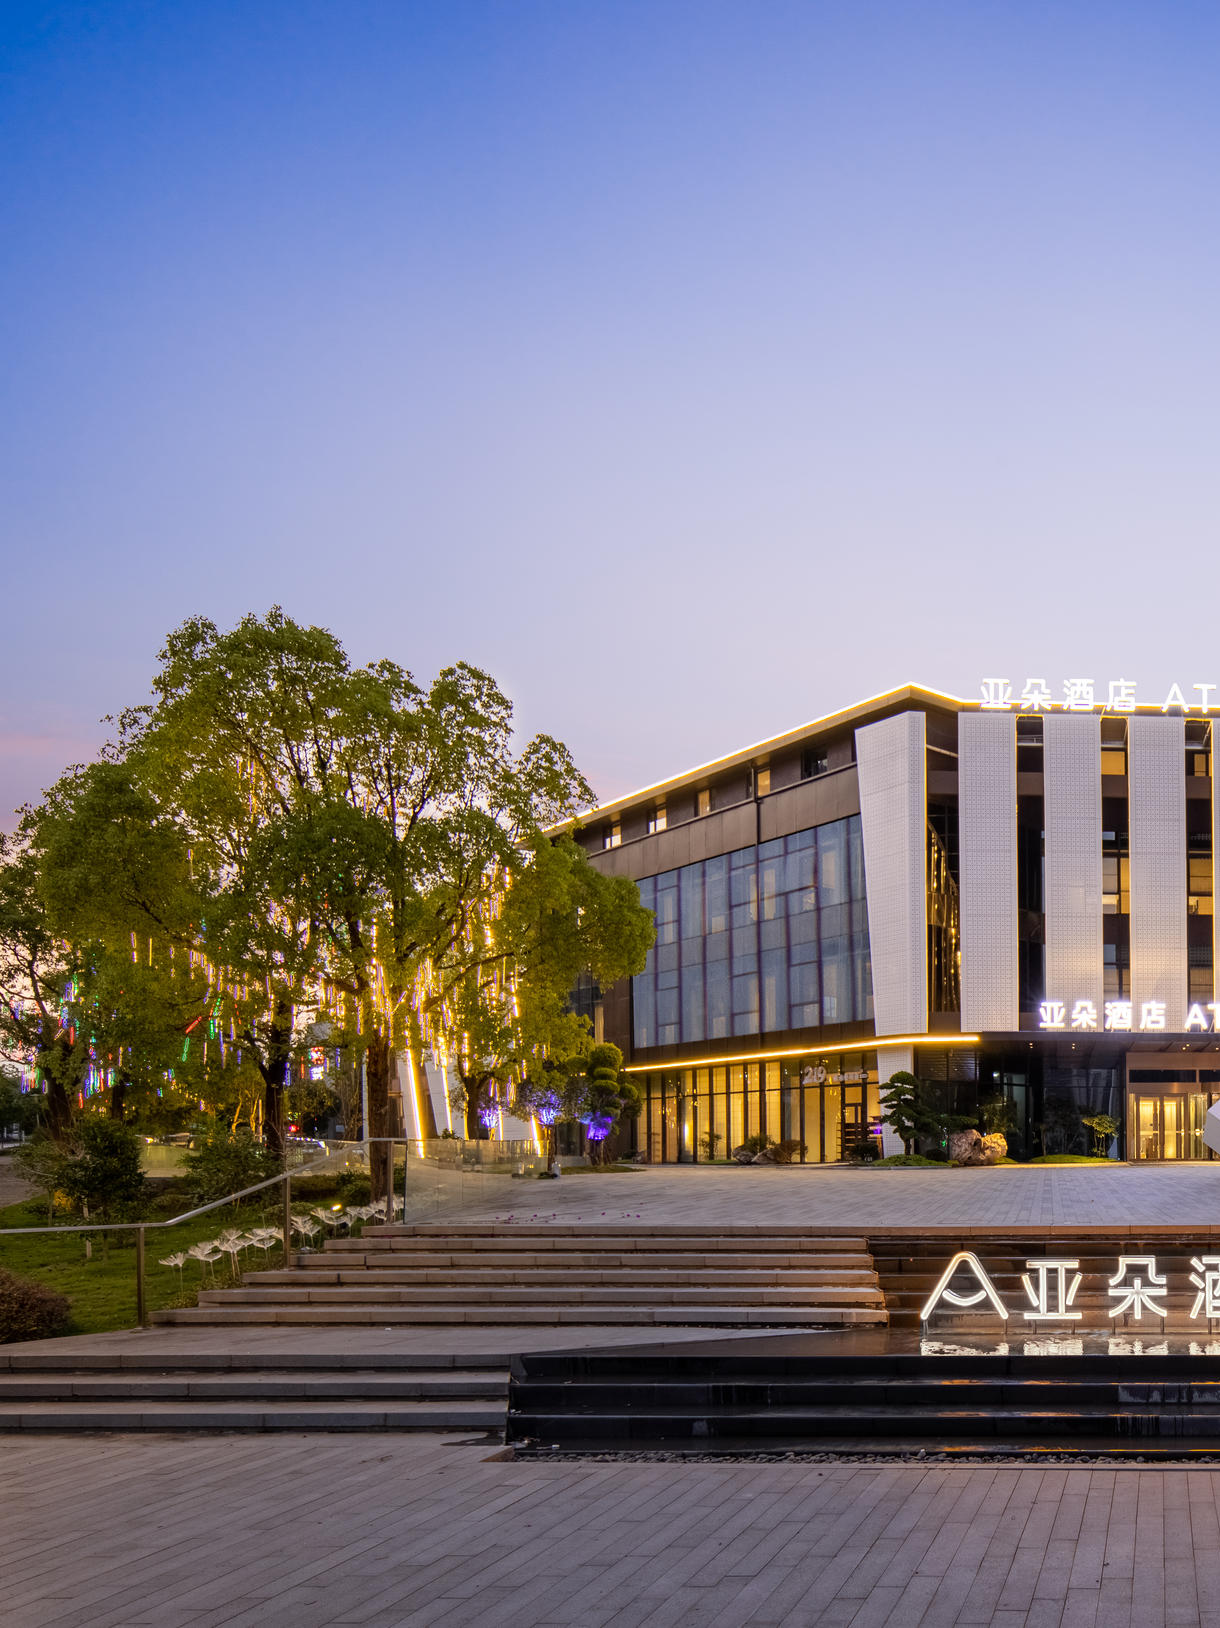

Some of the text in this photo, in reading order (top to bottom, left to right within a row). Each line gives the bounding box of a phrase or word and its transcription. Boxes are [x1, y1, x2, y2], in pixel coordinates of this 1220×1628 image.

[980, 678, 1137, 712] 亚朵酒店
[1039, 1001, 1167, 1030] 亚朵酒店
